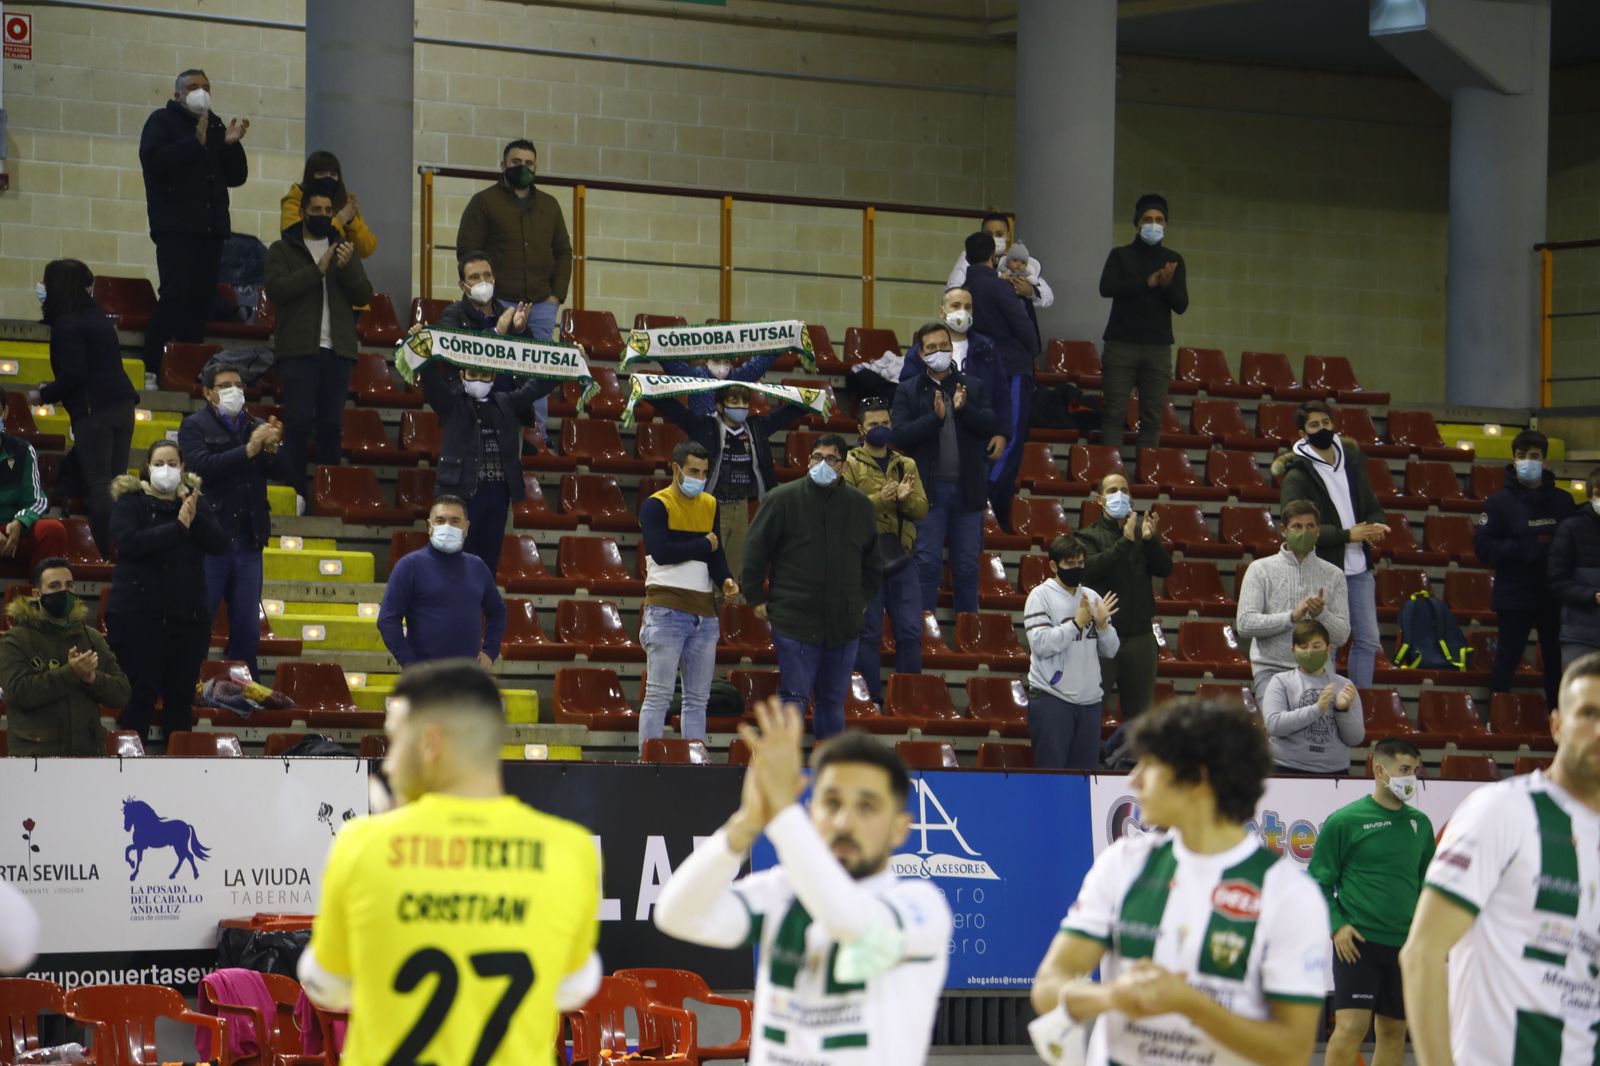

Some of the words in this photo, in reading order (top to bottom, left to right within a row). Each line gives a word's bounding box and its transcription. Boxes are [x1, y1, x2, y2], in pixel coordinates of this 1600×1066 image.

[656, 331, 735, 347] CÓRDOBA
[739, 325, 795, 342] FUTSAL
[439, 335, 517, 361] CÓRDOBA
[521, 348, 579, 367] FUTSAL
[33, 864, 100, 881] SEVILLA
[225, 869, 246, 887] LA
[252, 868, 311, 886] VIUDA
[935, 864, 986, 874] ASESORES
[131, 886, 144, 894] LA
[147, 885, 187, 894] POSADA
[230, 890, 312, 904] TABERNA
[131, 896, 151, 904] DEL
[153, 895, 203, 904] CABALLO
[396, 891, 531, 924] CRISTIAN
[131, 905, 180, 914] ANDALUZ
[383, 946, 535, 1066] 27
